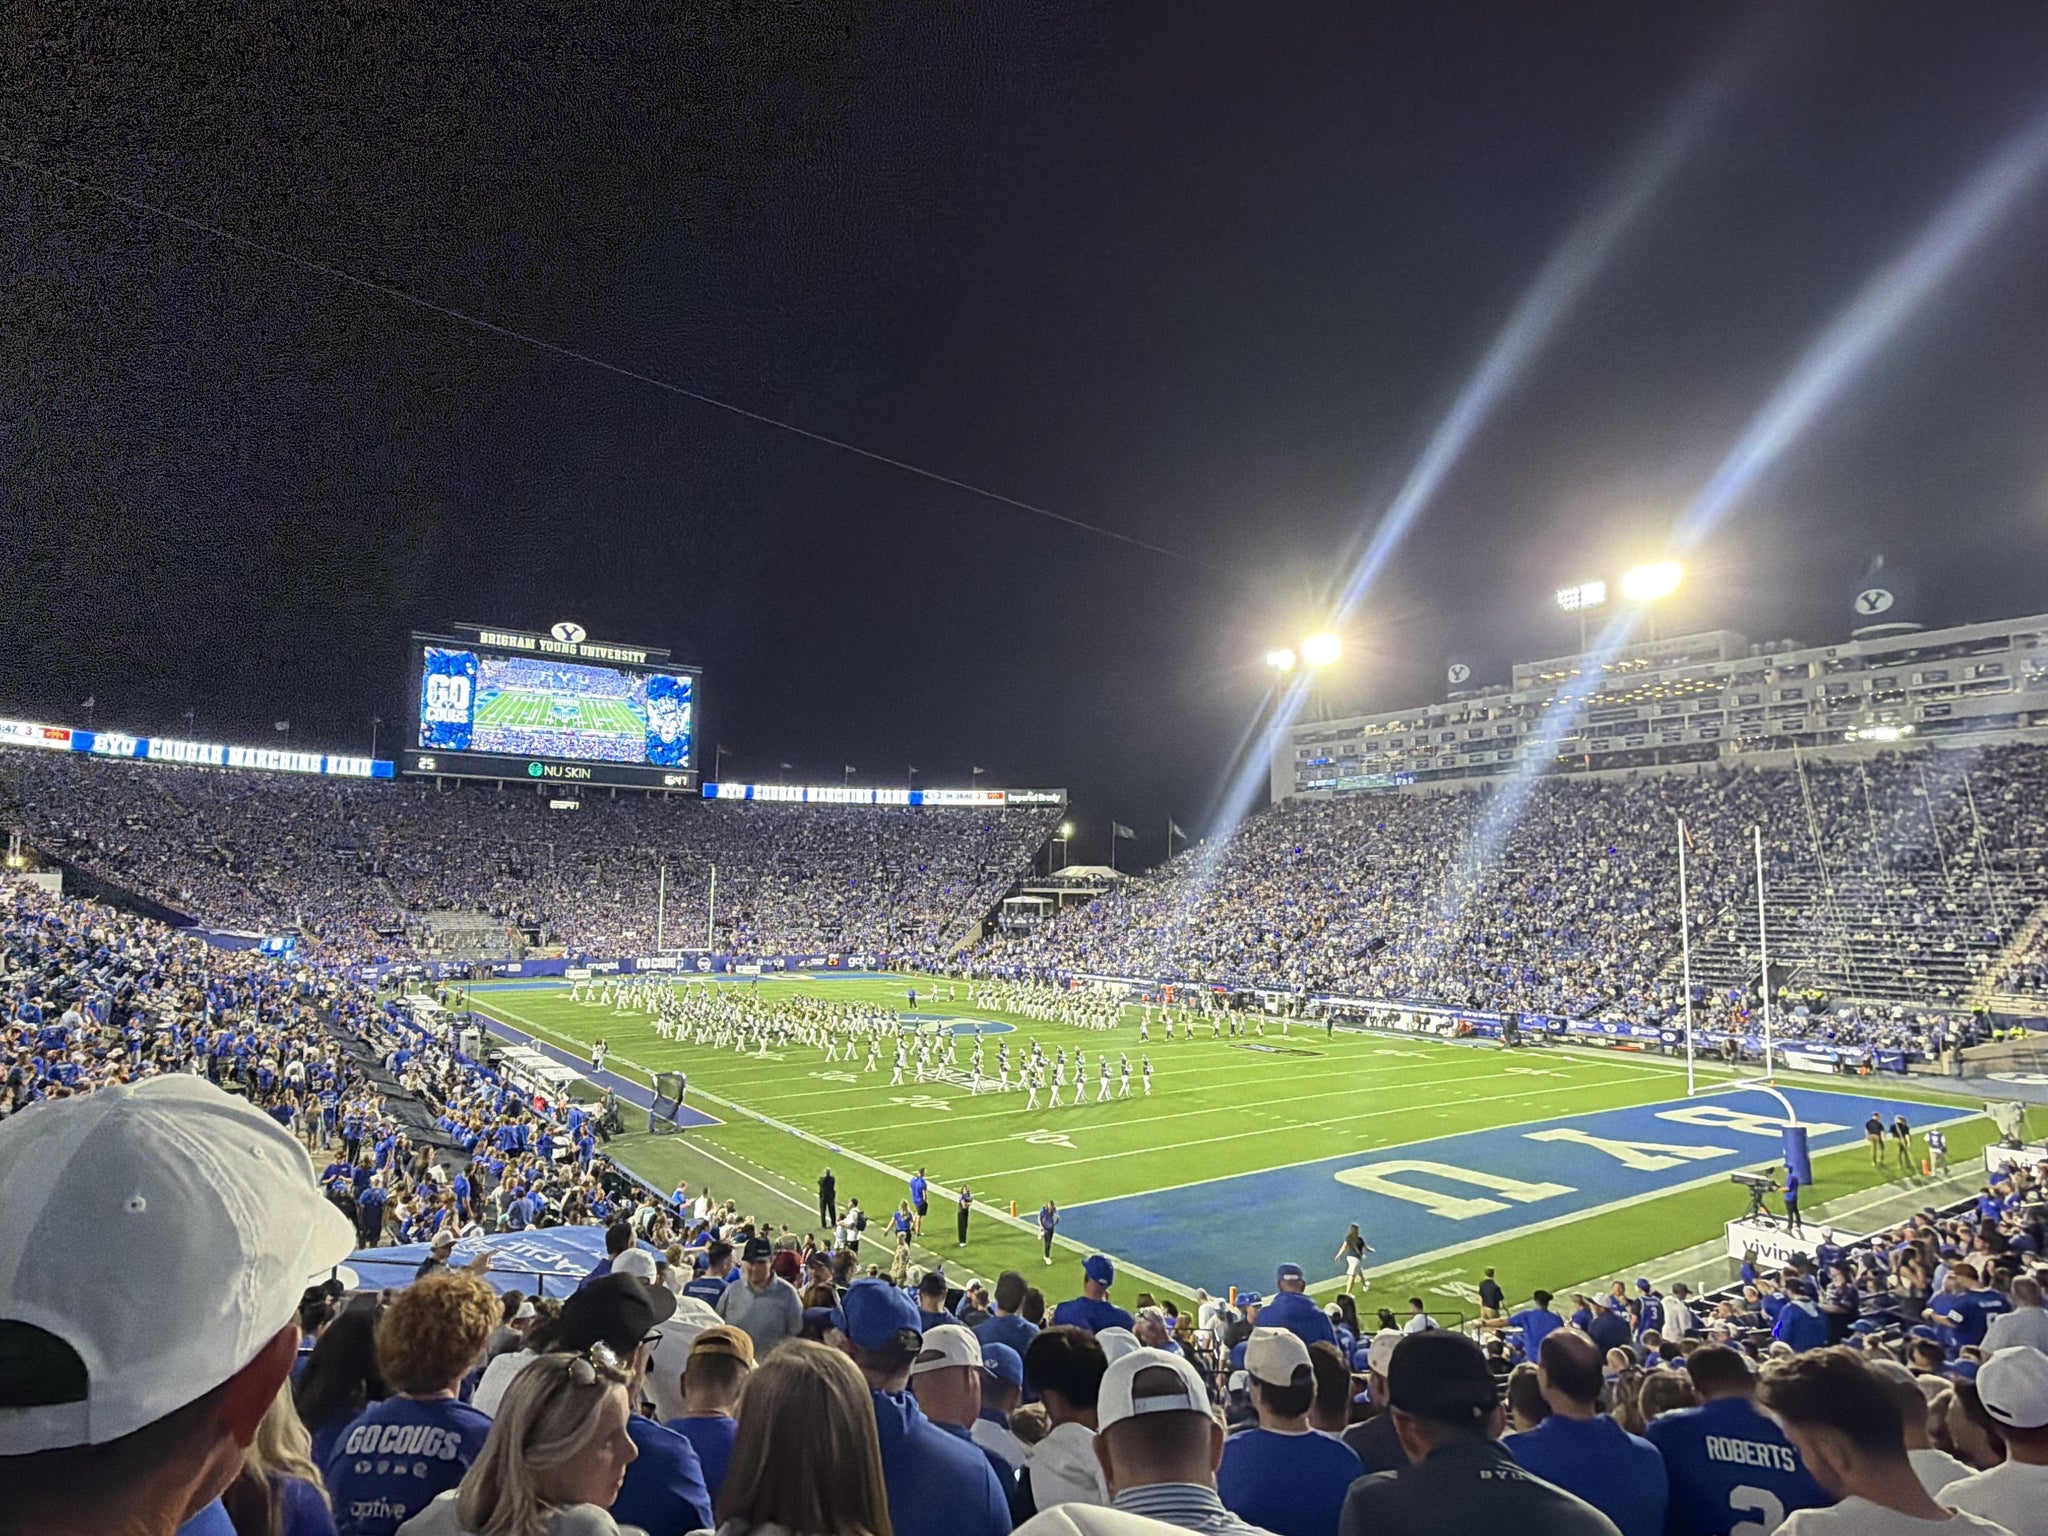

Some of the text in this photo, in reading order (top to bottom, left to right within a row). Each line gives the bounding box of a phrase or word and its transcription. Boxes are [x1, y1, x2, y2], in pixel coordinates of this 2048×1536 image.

[479, 631, 647, 663] BRIGHAM YOUNG UNIVERSITY
[427, 673, 470, 710] GO
[426, 707, 469, 723] COUGS
[94, 733, 136, 756] BYU
[148, 739, 223, 764] COUGAR
[228, 747, 322, 772] MARCHING
[327, 757, 372, 777] BAND
[544, 765, 591, 779] NU SKIN
[1743, 1239, 1797, 1260] vivin
[1650, 1306, 1658, 1320] 3
[345, 1425, 462, 1460] GO COUGS
[1705, 1435, 1796, 1472] ROBERTS
